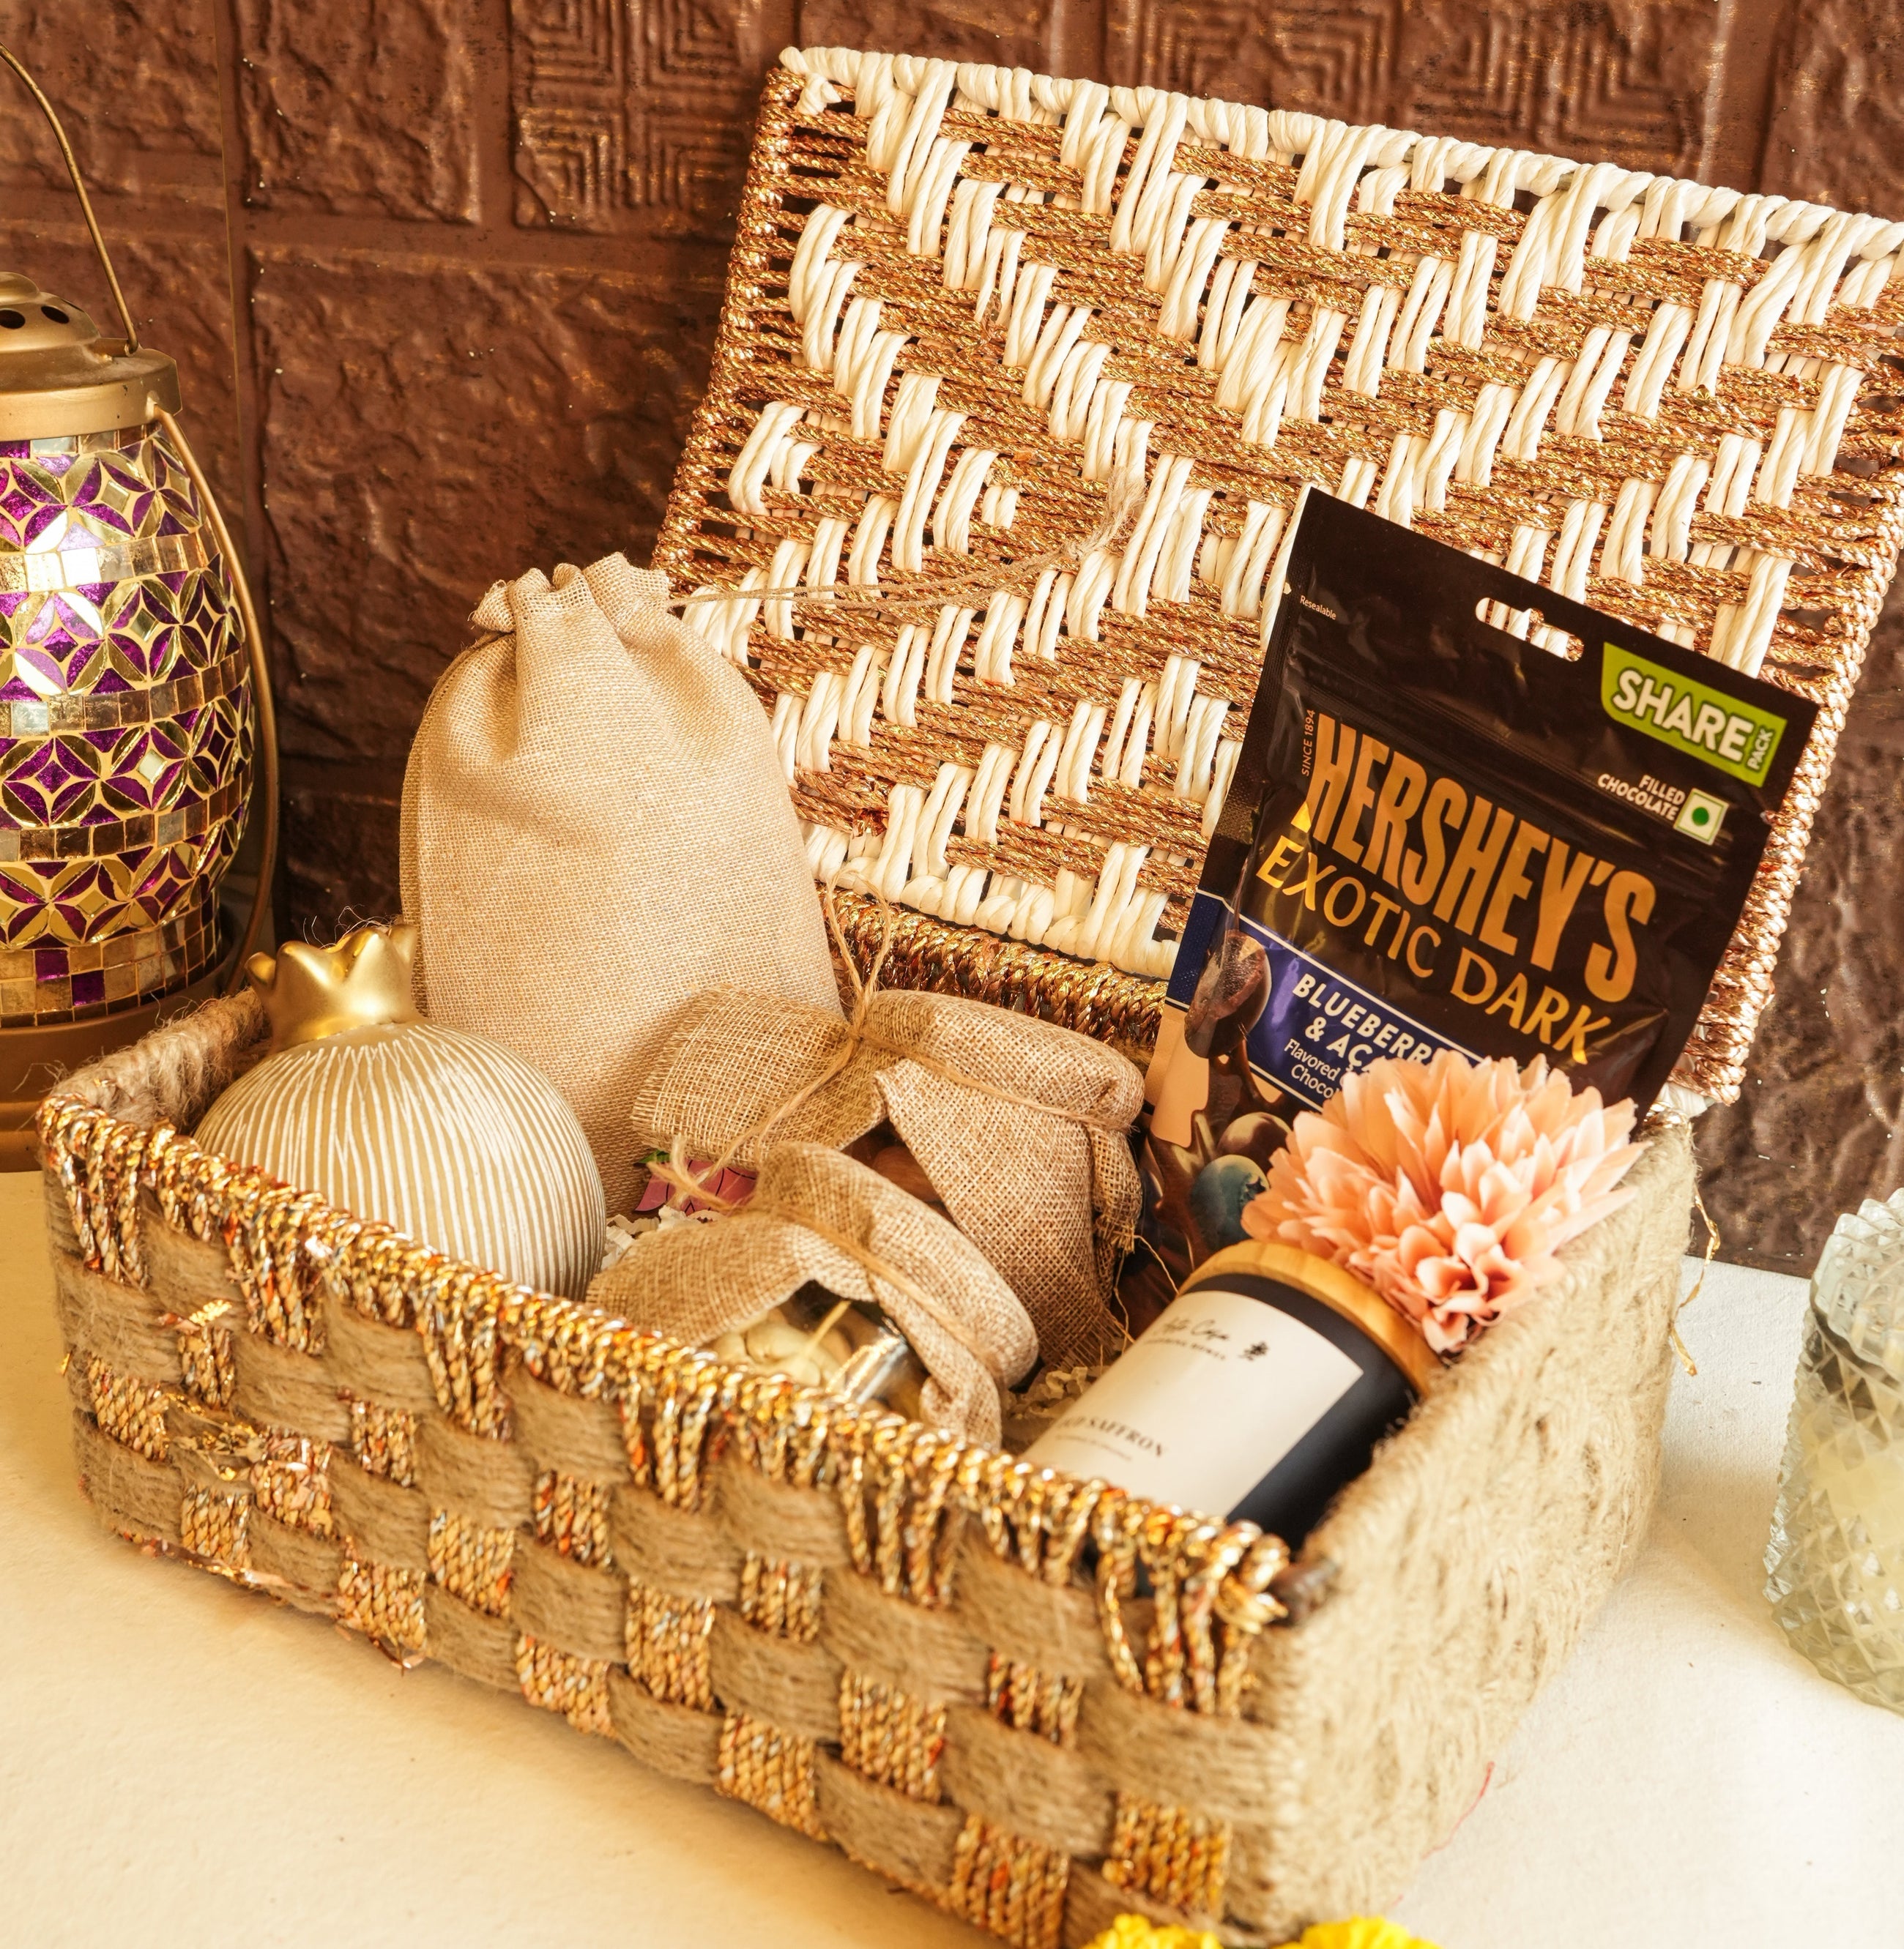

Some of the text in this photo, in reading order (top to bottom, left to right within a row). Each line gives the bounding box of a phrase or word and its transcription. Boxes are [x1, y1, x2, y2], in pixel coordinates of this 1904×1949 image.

[1300, 595, 1336, 621] Resealable
[1613, 669, 1754, 763] SHARE
[1301, 709, 1316, 777] SINCE 1894
[1747, 728, 1774, 770] PACK
[1597, 773, 1680, 821] CHOCOLATE
[1638, 775, 1686, 806] FILLED
[1290, 712, 1656, 1002] HERSHEY'S
[1256, 835, 1610, 1065] EXOTIC DARK
[1293, 973, 1433, 1064] BLUEBERR
[1304, 1016, 1326, 1042] &
[1284, 1038, 1341, 1081] Flavored
[1291, 1064, 1339, 1098] Choco
